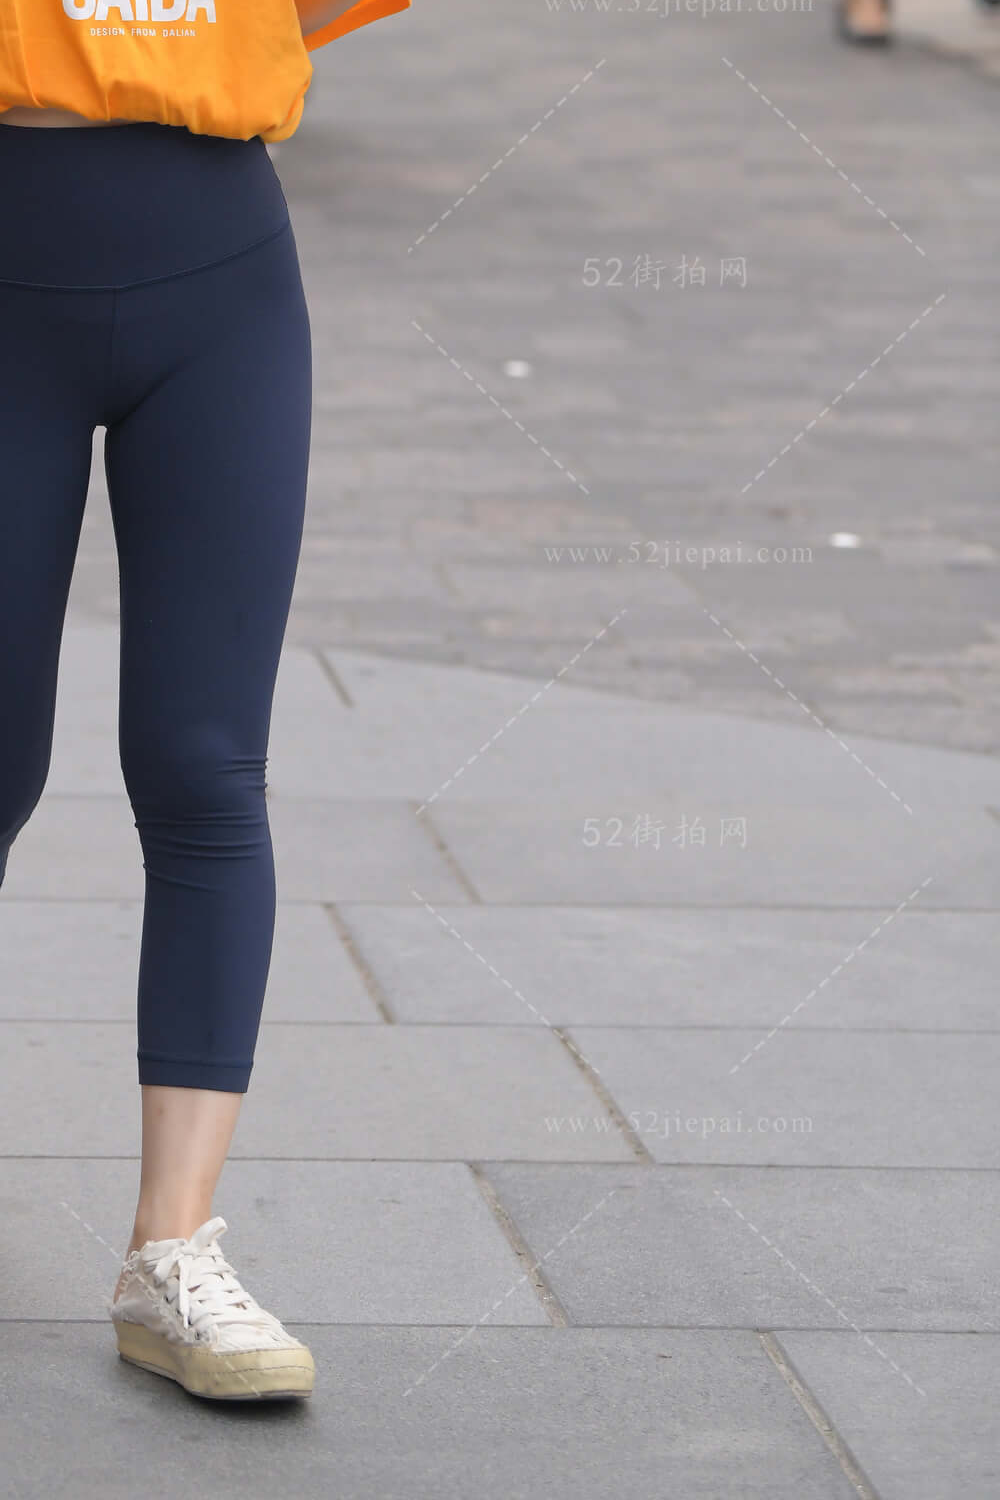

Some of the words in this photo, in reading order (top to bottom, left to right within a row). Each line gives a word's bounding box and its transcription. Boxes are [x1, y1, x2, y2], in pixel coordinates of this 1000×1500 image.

[90, 27, 126, 37] DESIGN
[131, 27, 157, 37] FROM
[162, 28, 196, 38] DALIAN
